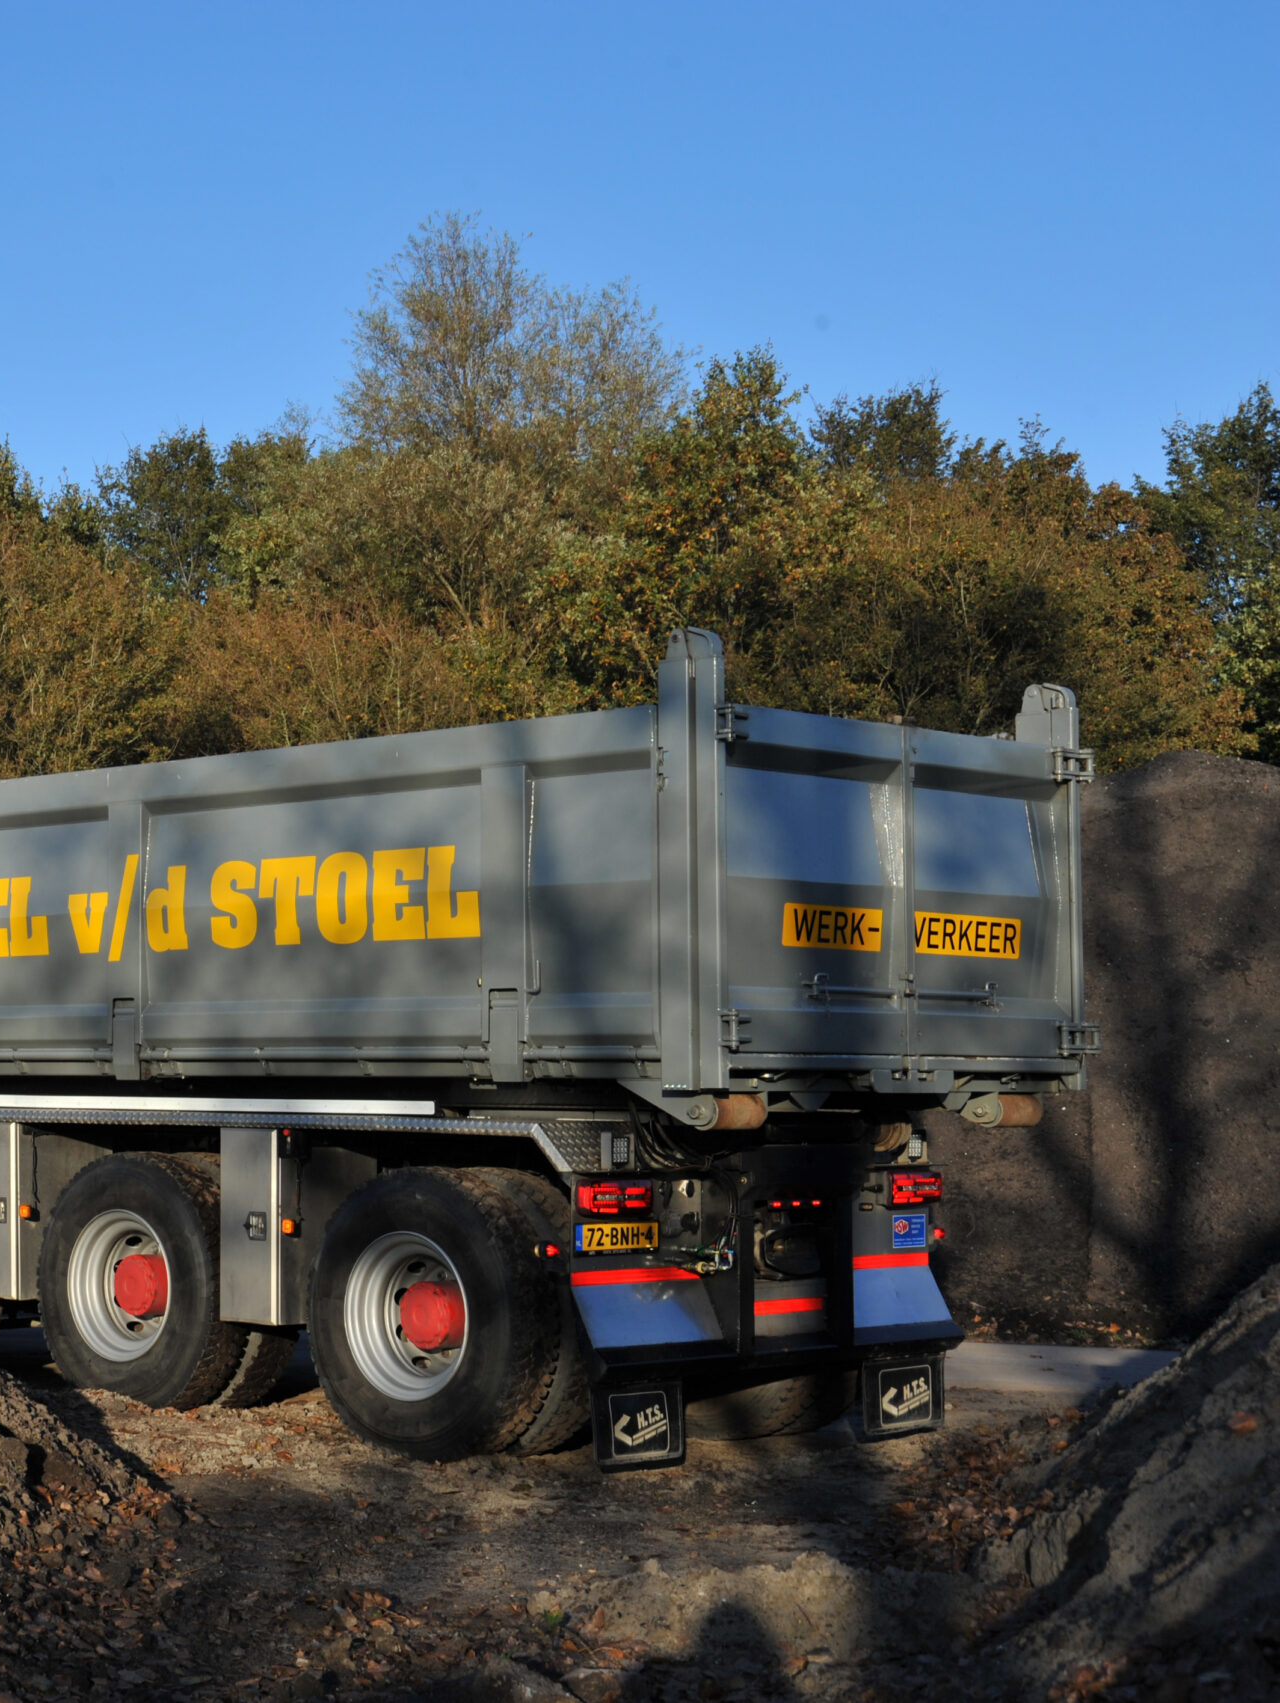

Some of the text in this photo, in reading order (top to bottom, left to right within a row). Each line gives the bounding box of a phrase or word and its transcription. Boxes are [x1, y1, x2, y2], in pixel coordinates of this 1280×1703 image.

[68, 853, 188, 962] v/d
[210, 845, 481, 949] STOEL
[793, 908, 1018, 954] WERK- VERKEER
[586, 1225, 654, 1247] 72-BNH-4
[902, 1376, 928, 1401] H.T.S.
[636, 1404, 664, 1430] H.T.S.
